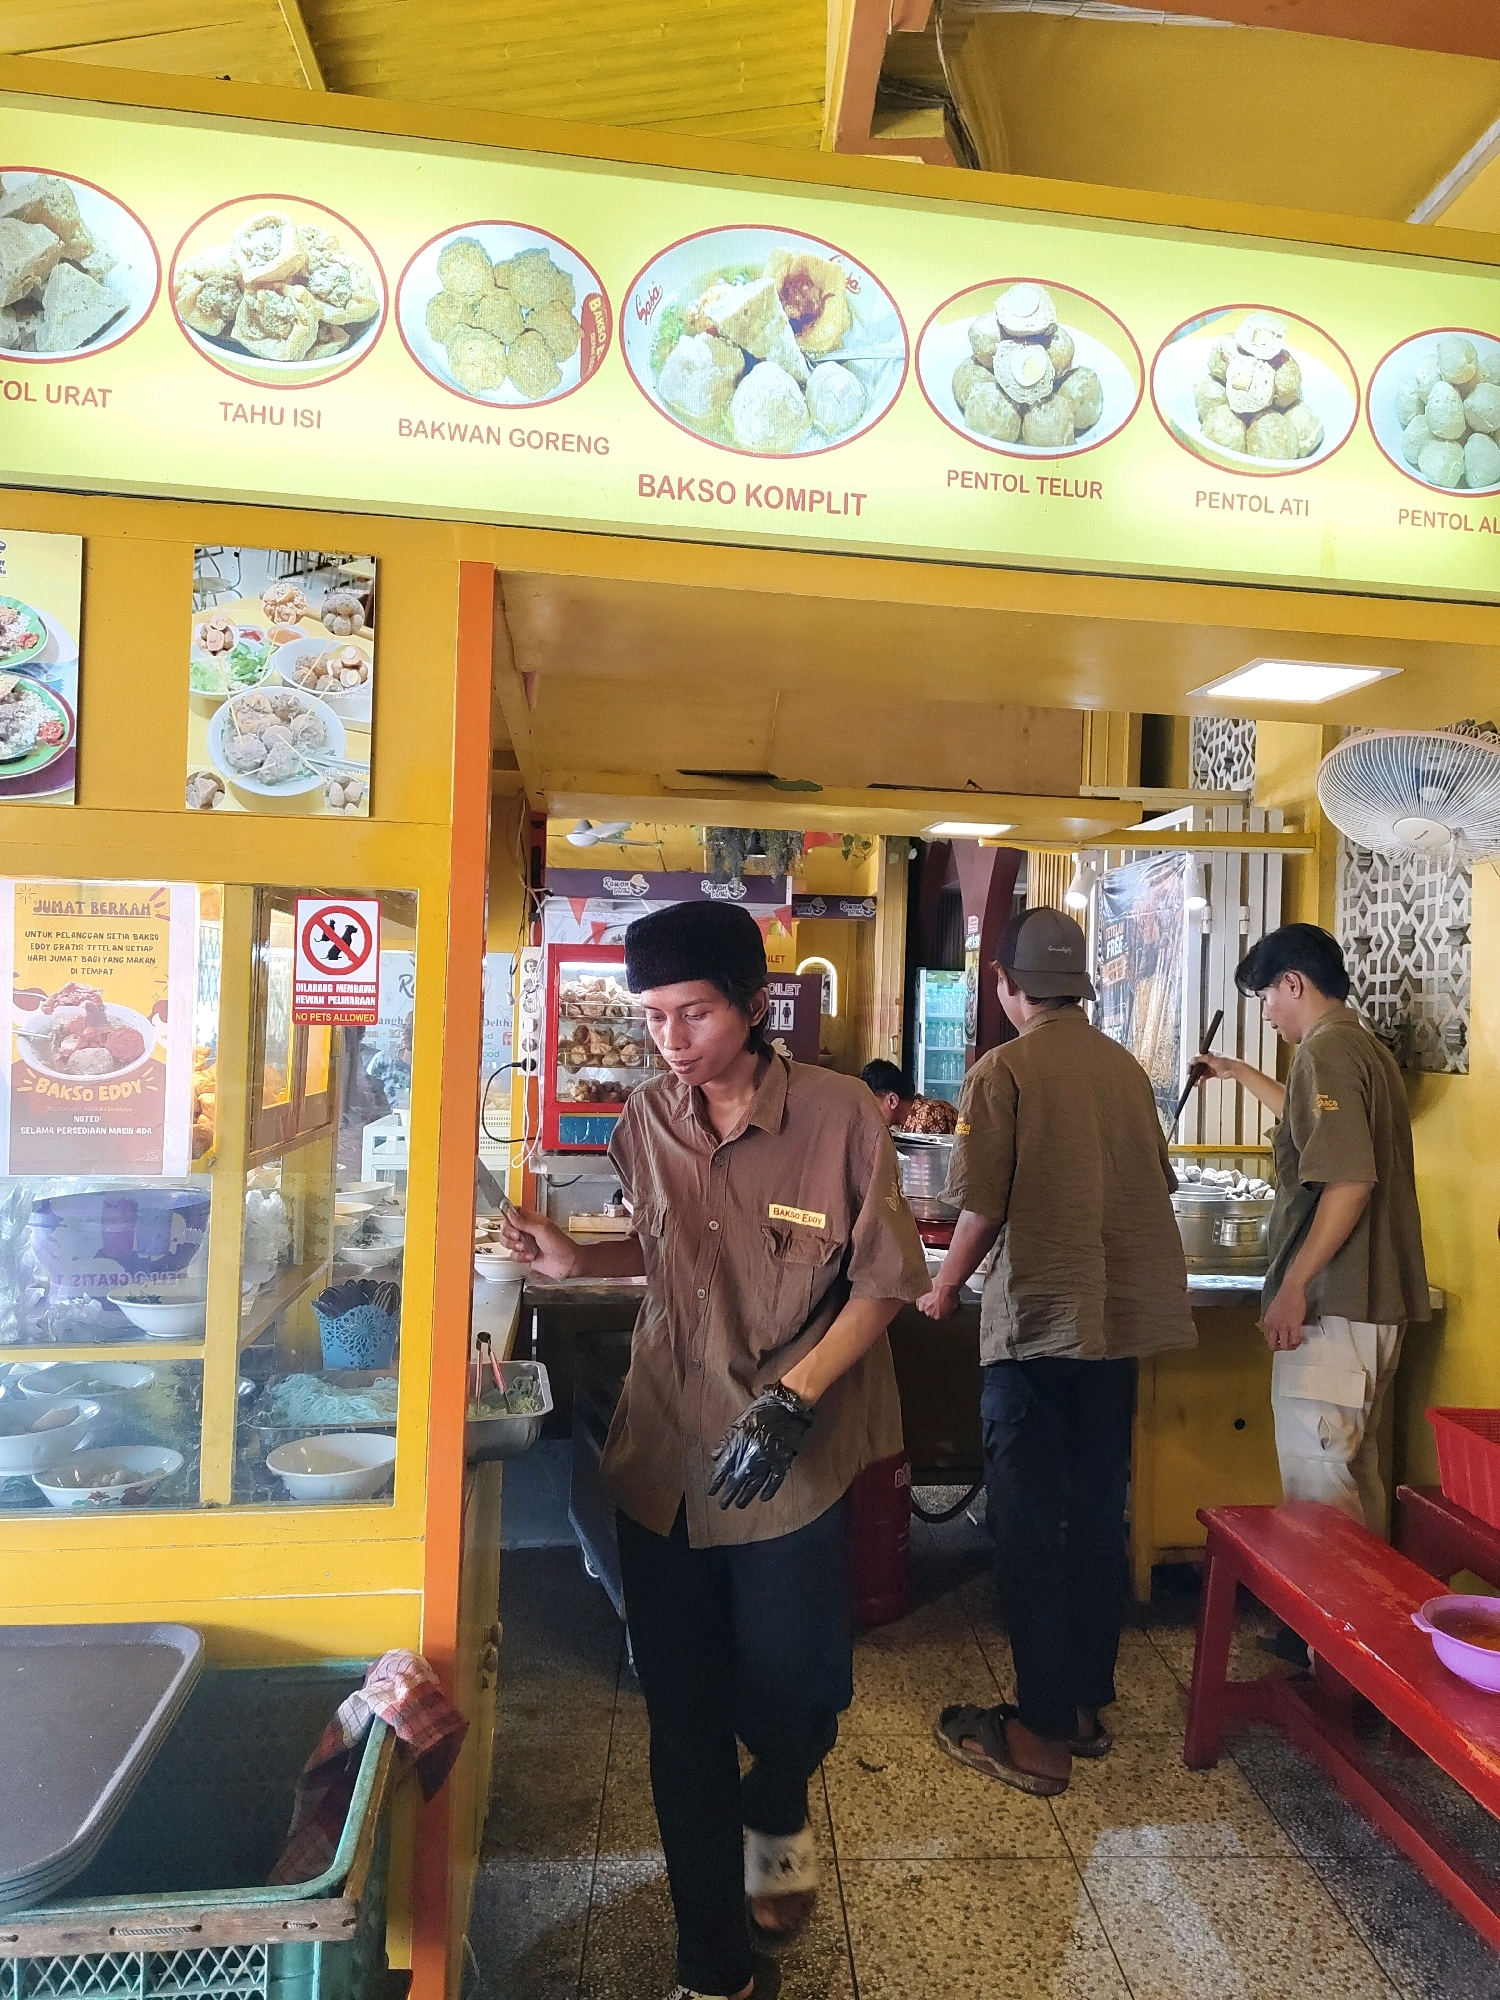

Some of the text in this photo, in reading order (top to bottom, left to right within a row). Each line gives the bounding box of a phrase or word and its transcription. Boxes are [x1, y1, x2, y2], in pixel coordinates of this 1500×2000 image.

[45, 383, 113, 408] URAT
[218, 401, 322, 429] TAHU ISI
[398, 417, 610, 456] BAKWAN GORENG
[947, 469, 1103, 500] PENTOL TELUR
[638, 473, 868, 516] BAKSO KOMPLIT
[1195, 490, 1309, 517] PENTOL ATI
[1398, 508, 1474, 532] PENTOL
[33, 899, 151, 916] JUMAT BERKAH
[25, 930, 159, 941] UNTUK PELANGGAN SETIA BAKSO
[30, 942, 154, 952] EDDY GRATIS TETELAN SETIAP
[27, 954, 47, 962] HARI
[49, 955, 78, 963] JUMAT
[102, 956, 124, 964] YANG
[126, 957, 156, 965] MAKAN
[767, 954, 786, 964] ILET
[81, 968, 114, 976] TEMPAT
[295, 982, 333, 993] DILARANG
[768, 983, 801, 996] OILET
[295, 995, 376, 1006] HEWAN PELIHARAAN
[296, 1013, 375, 1022] NO PETS ALLOWED
[35, 1077, 142, 1102] BAKSO EDDY
[20, 1126, 152, 1135] SELAMA PERSEDIAAN MASIH ADA
